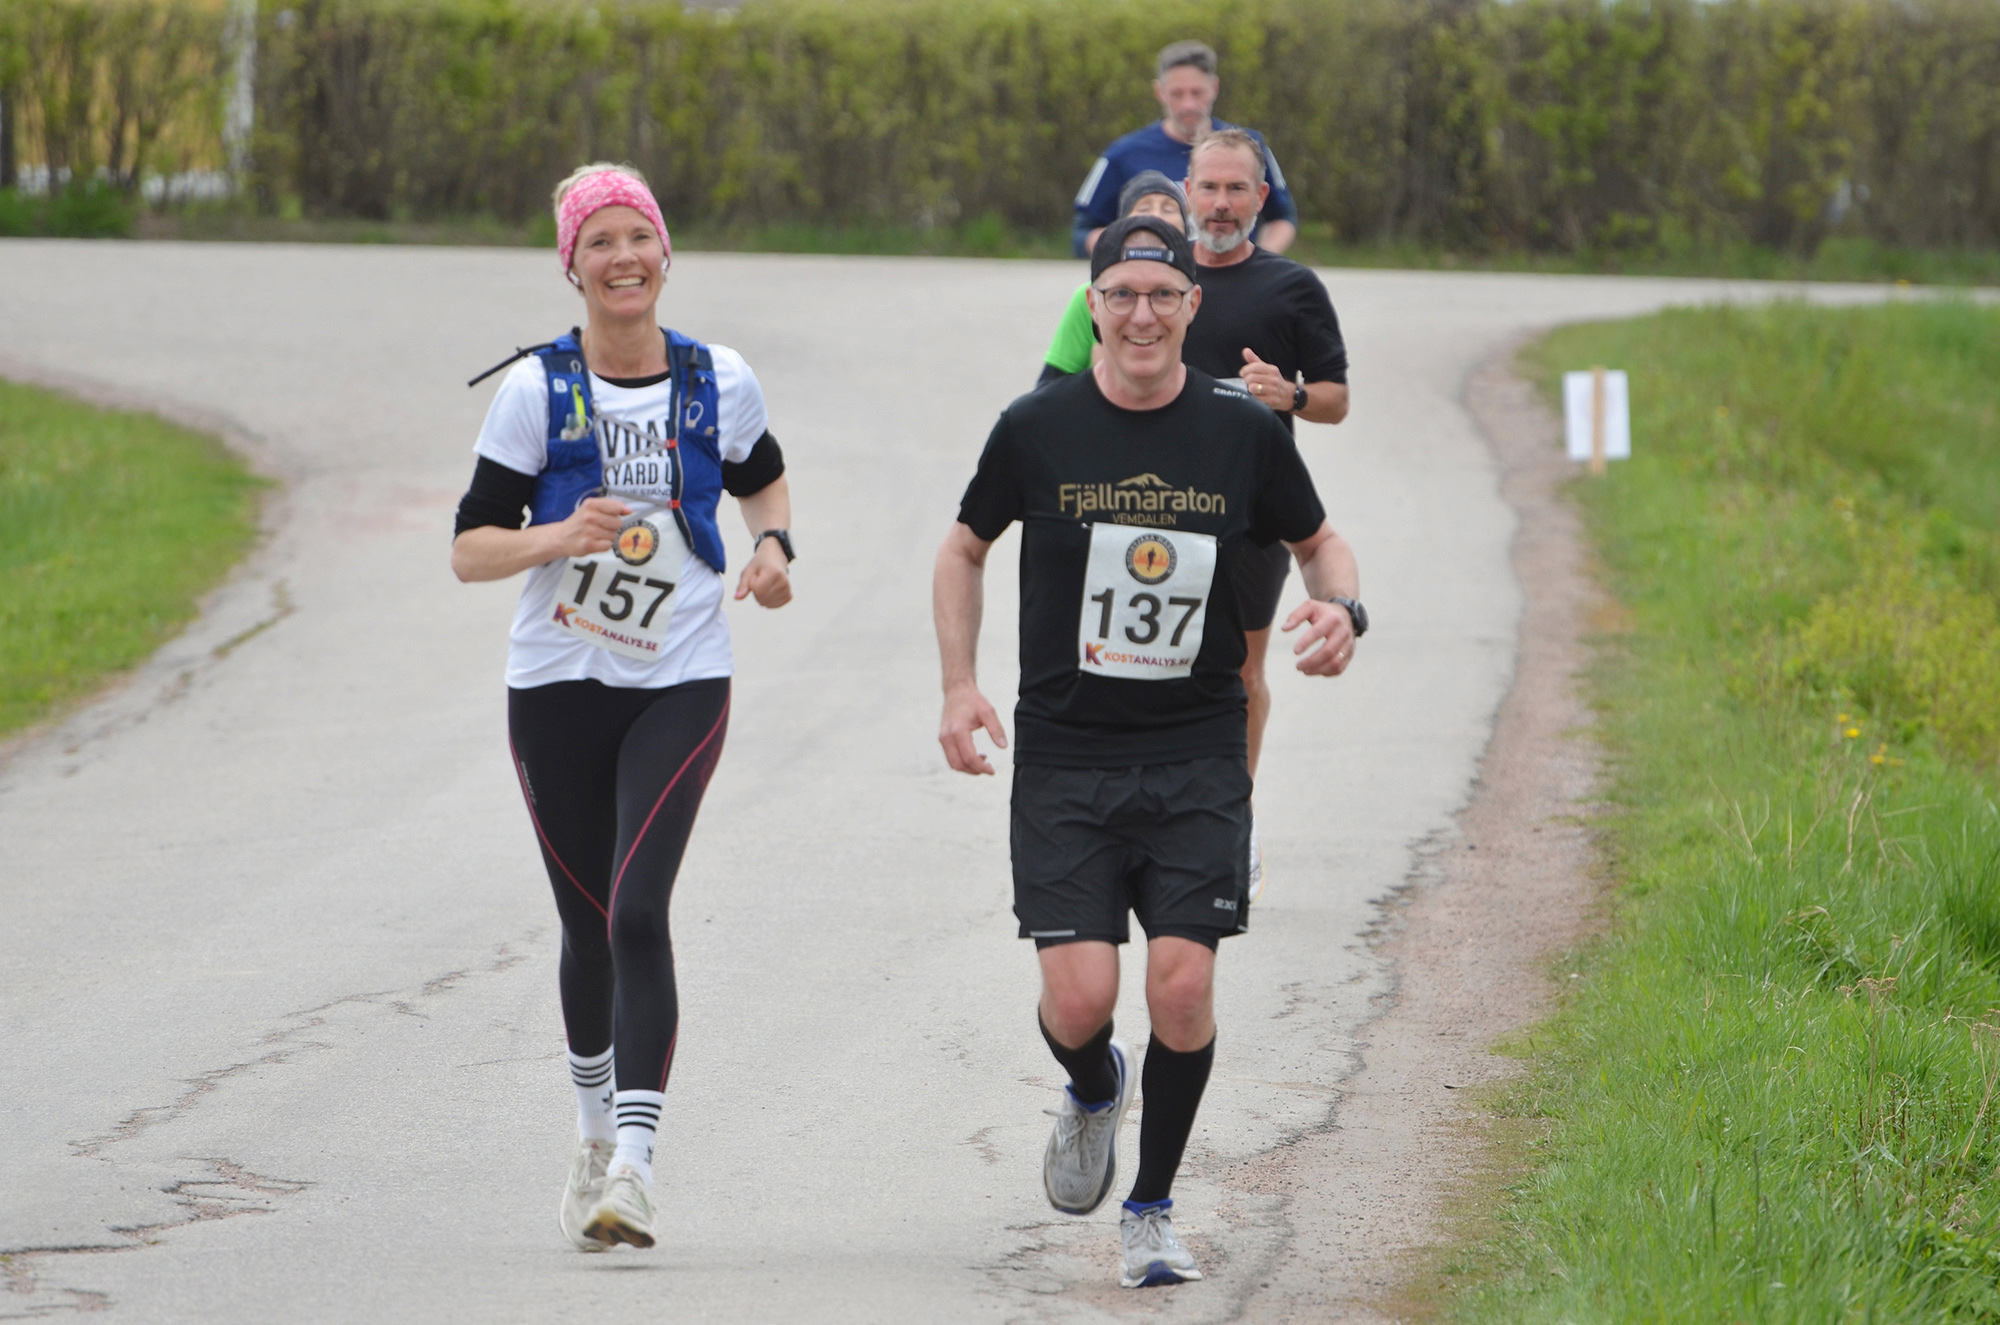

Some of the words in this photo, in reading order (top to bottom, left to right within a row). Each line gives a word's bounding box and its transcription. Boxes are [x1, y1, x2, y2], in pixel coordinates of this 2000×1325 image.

[1059, 483, 1226, 519] Fjällmaraton
[1113, 513, 1177, 525] VEMDALEN
[573, 560, 675, 629] 157
[574, 615, 659, 652] KOSTANALYS.SE
[1091, 588, 1203, 647] 137
[1104, 651, 1191, 667] KOSTANALYS.SE
